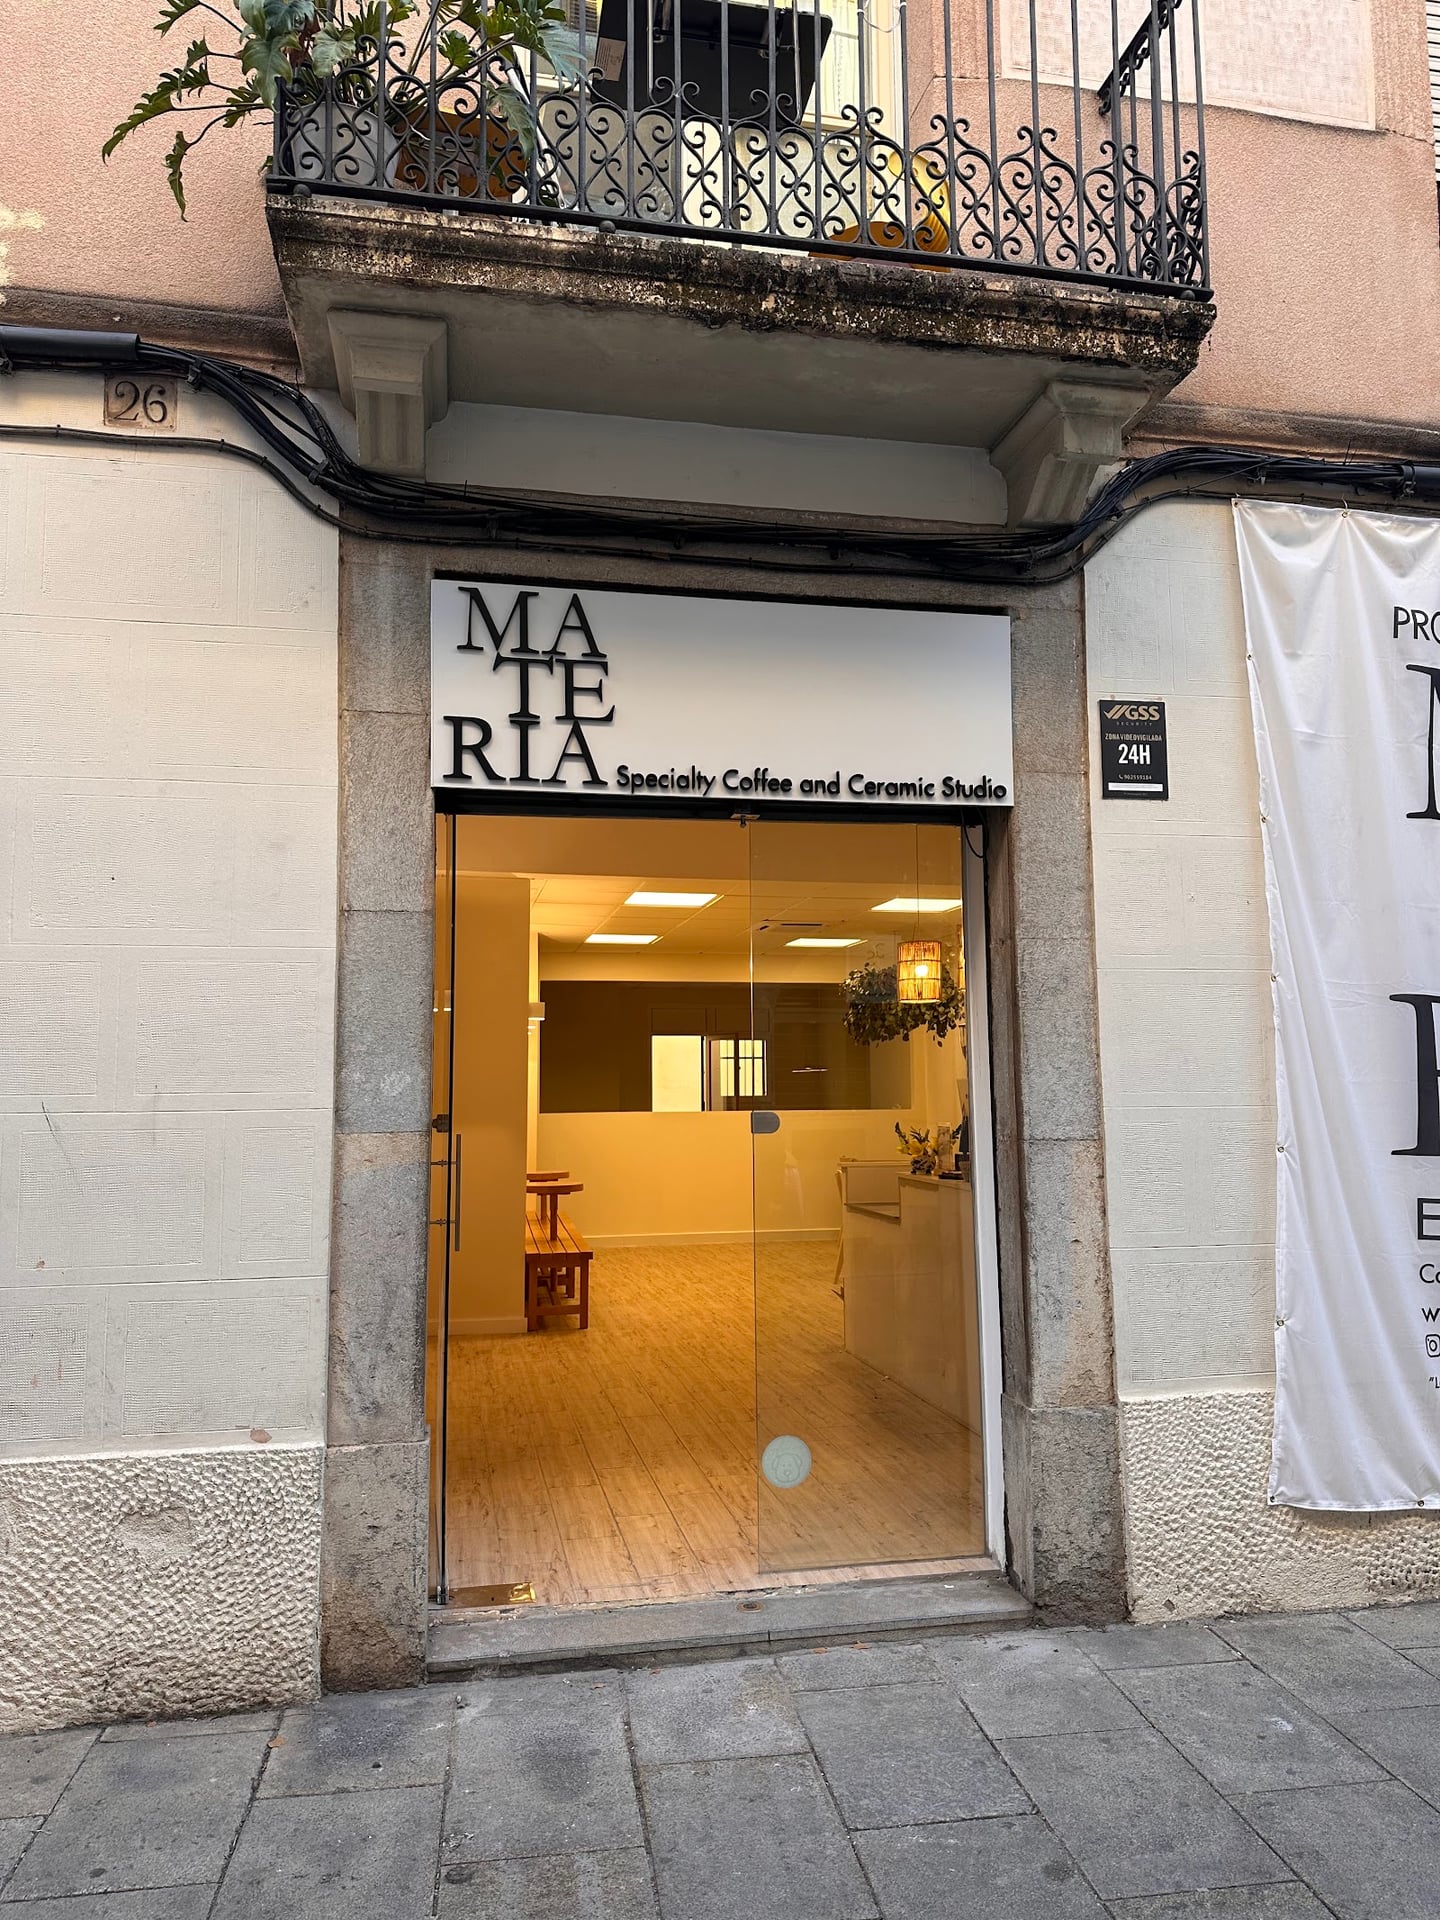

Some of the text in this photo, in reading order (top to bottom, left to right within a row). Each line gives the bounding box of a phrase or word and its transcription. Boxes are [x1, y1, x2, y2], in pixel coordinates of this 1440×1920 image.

[114, 380, 167, 423] 26
[457, 586, 608, 658] MA
[493, 652, 616, 722] TE
[1124, 705, 1160, 721] GSS
[443, 715, 608, 785] RIA
[1105, 733, 1120, 741] ZONA
[1118, 743, 1150, 764] 24H
[616, 764, 1007, 799] Specialty Coffee and Ceramic Studio
